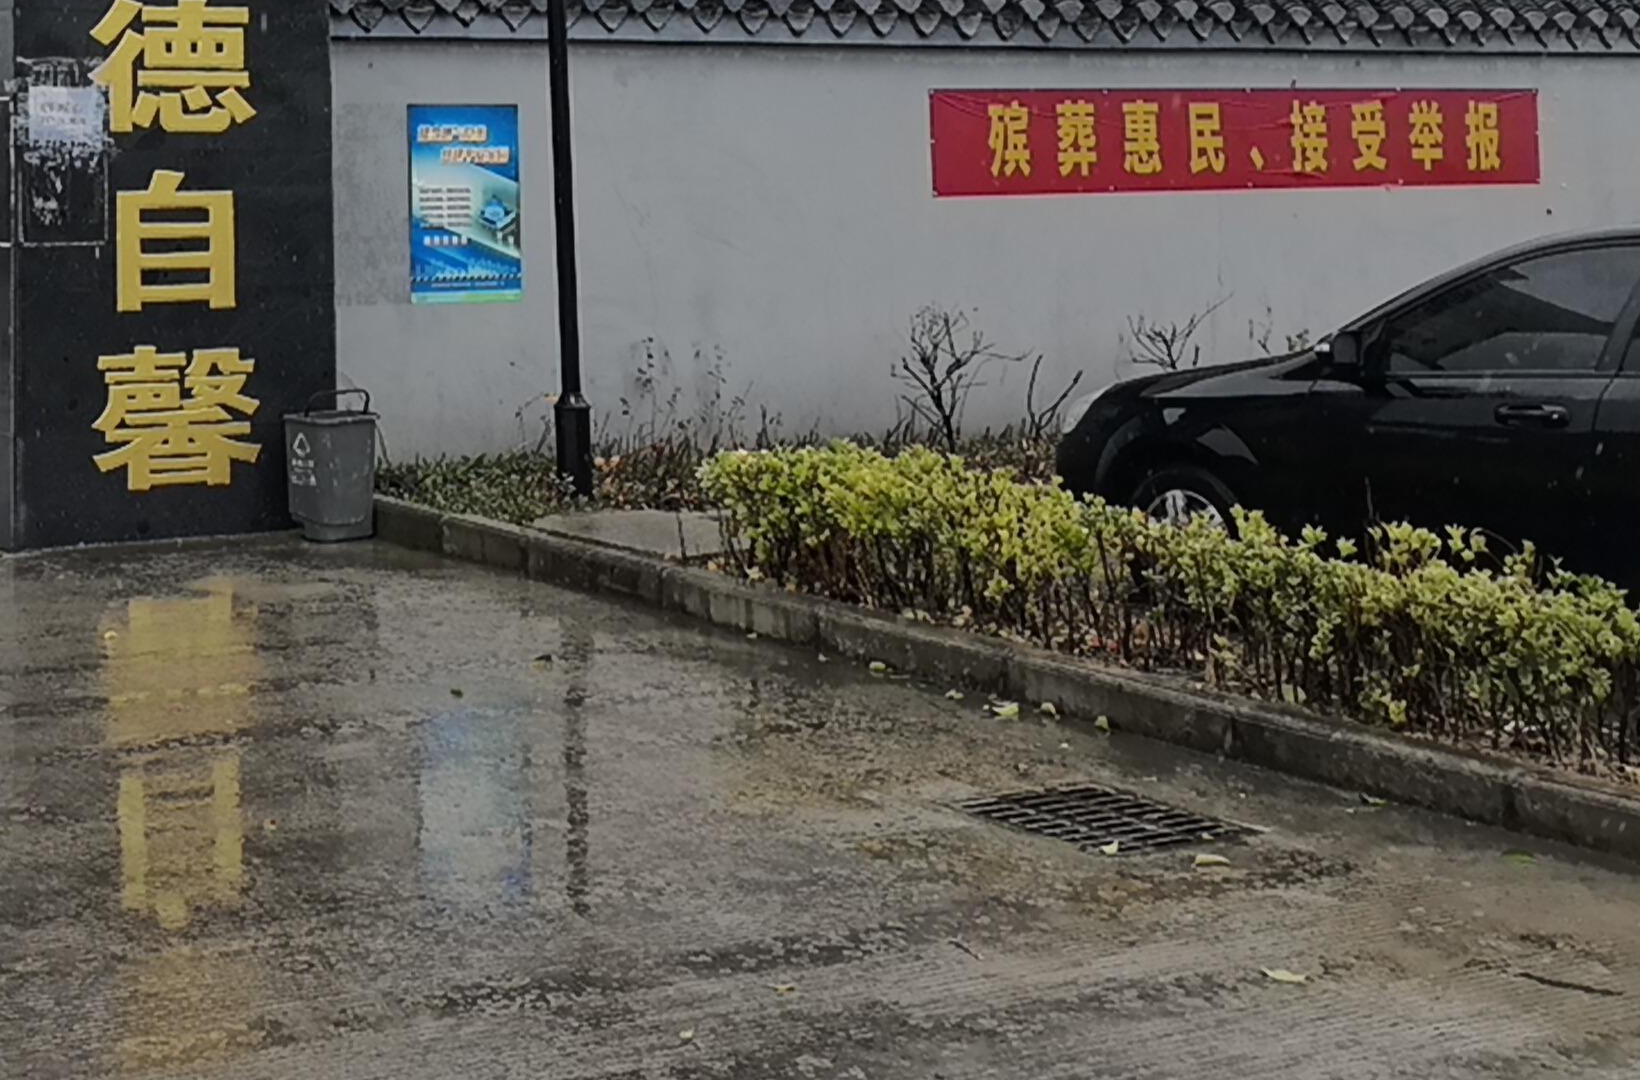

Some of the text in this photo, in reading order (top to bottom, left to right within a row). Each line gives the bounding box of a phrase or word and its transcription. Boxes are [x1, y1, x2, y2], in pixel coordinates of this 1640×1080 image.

[987, 100, 1501, 177] 殡葬惠民、接受举报
